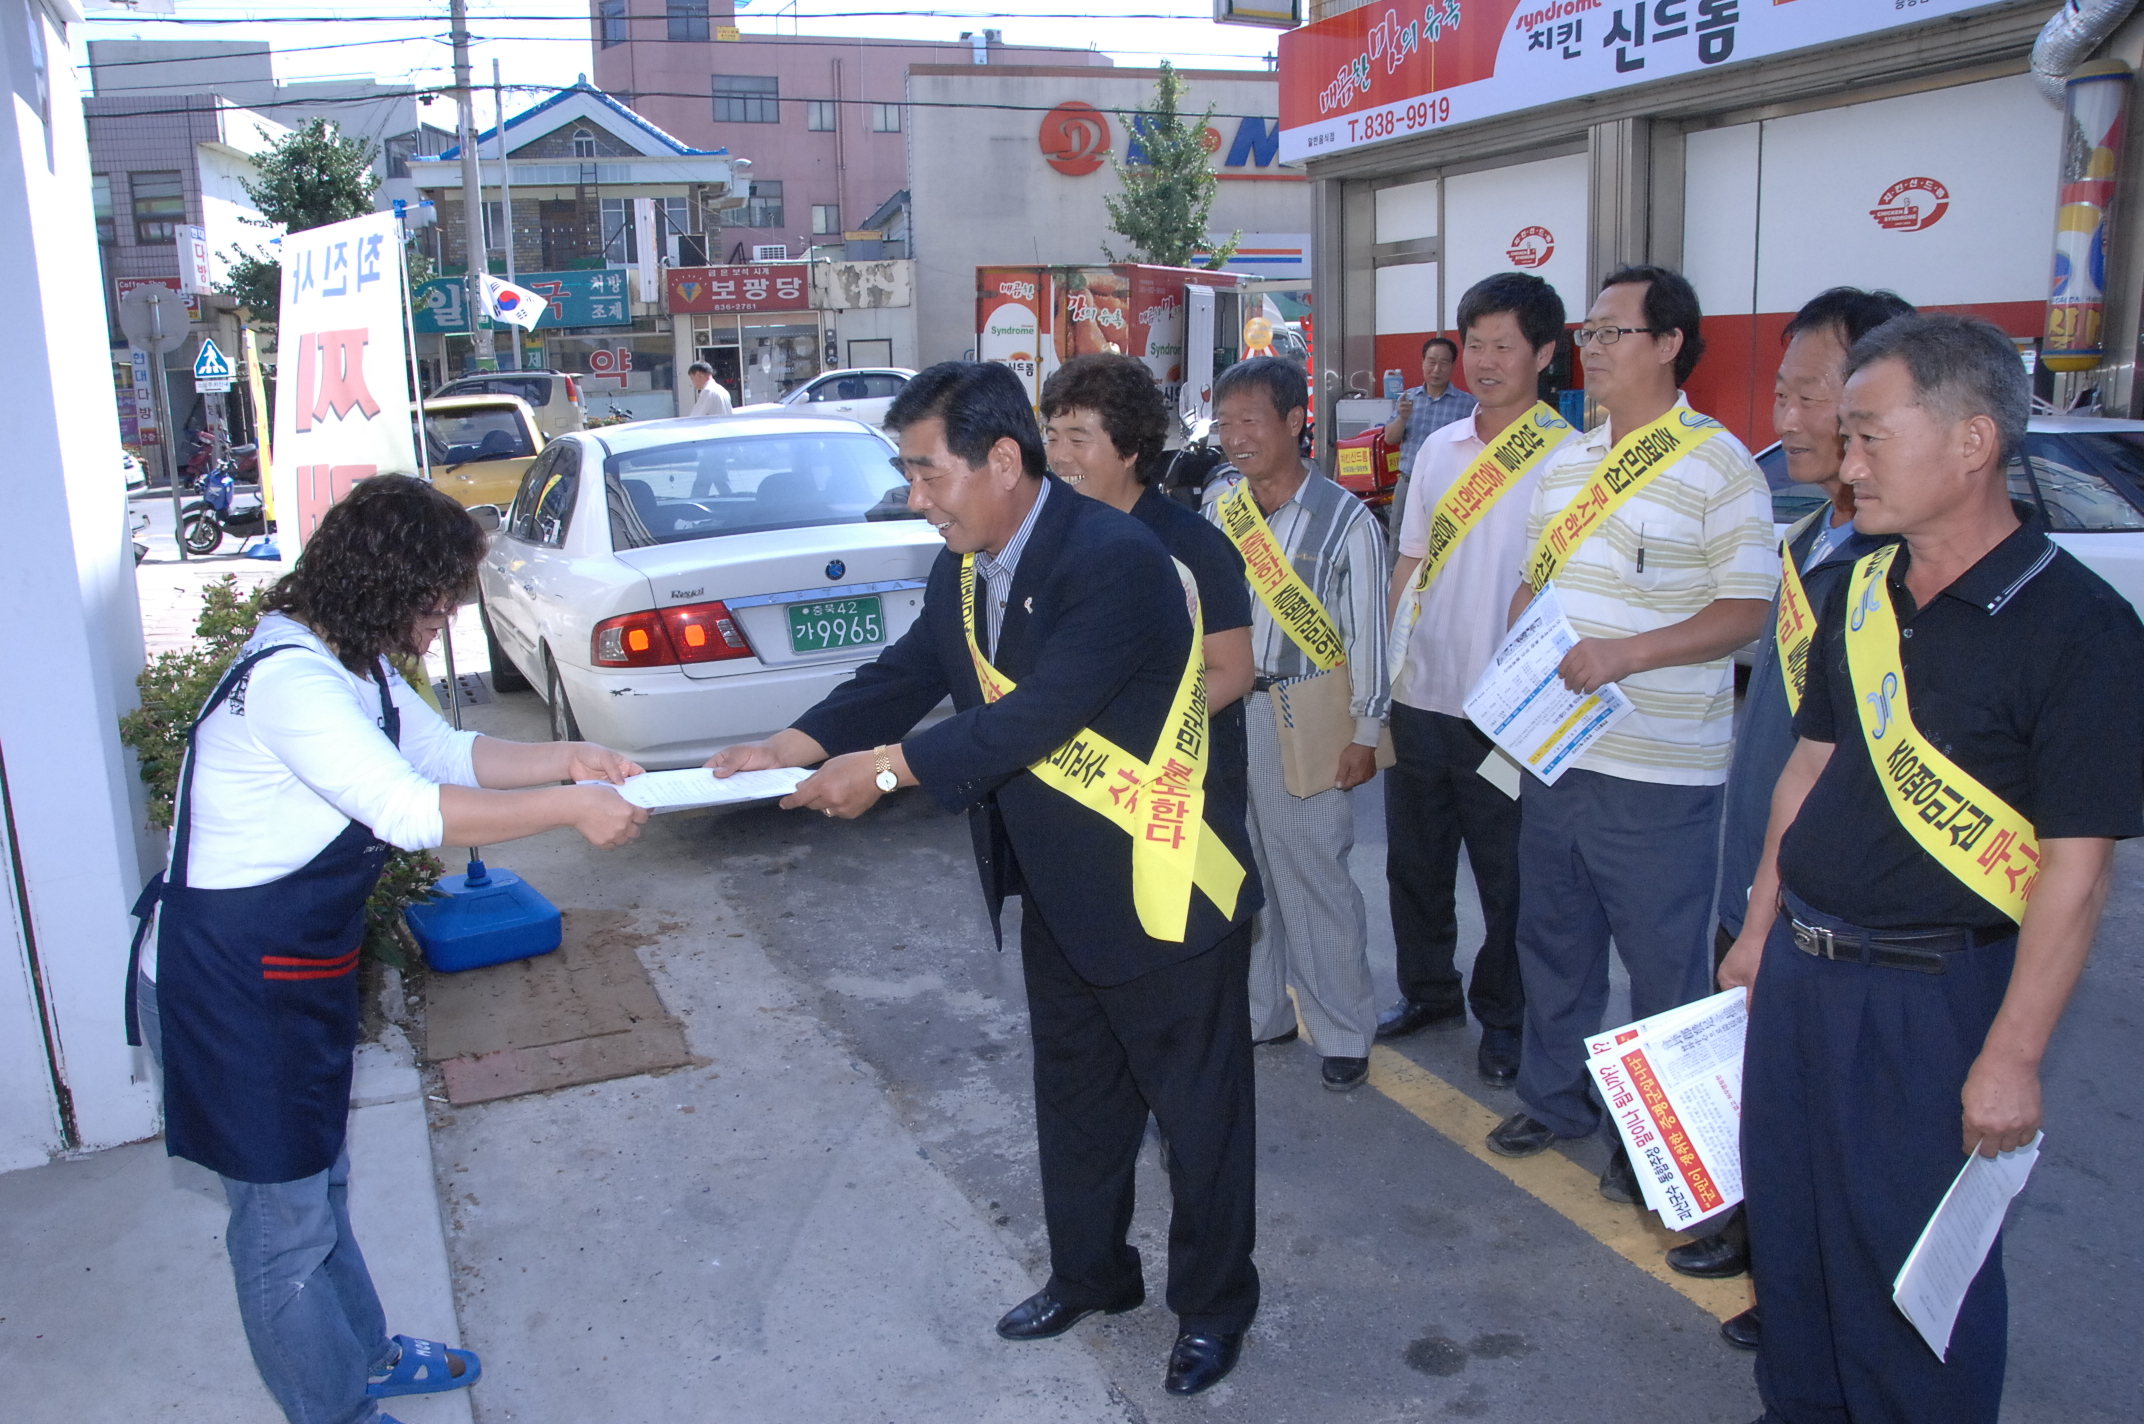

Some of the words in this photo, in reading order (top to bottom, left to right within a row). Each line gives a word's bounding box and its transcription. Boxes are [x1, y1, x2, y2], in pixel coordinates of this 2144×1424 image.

[1528, 18, 1582, 60] 치킨
[1347, 96, 1451, 143] T.838-9919
[590, 273, 621, 293] 처방
[711, 276, 802, 300] 보광당
[592, 302, 623, 320] 조제
[714, 303, 757, 311] 836-2781
[991, 326, 1034, 336] Syndrome
[1604, 427, 1681, 494] 증평민심
[1550, 483, 1609, 556] 무시하는
[796, 614, 881, 648] 가9965
[1887, 739, 1995, 852] 증평민심
[1622, 1109, 1655, 1148] 말이나
[1645, 1147, 1674, 1184] 통합주장
[1669, 1132, 1695, 1166] 쟁취한
[1665, 1184, 1692, 1221] 괴산군수
